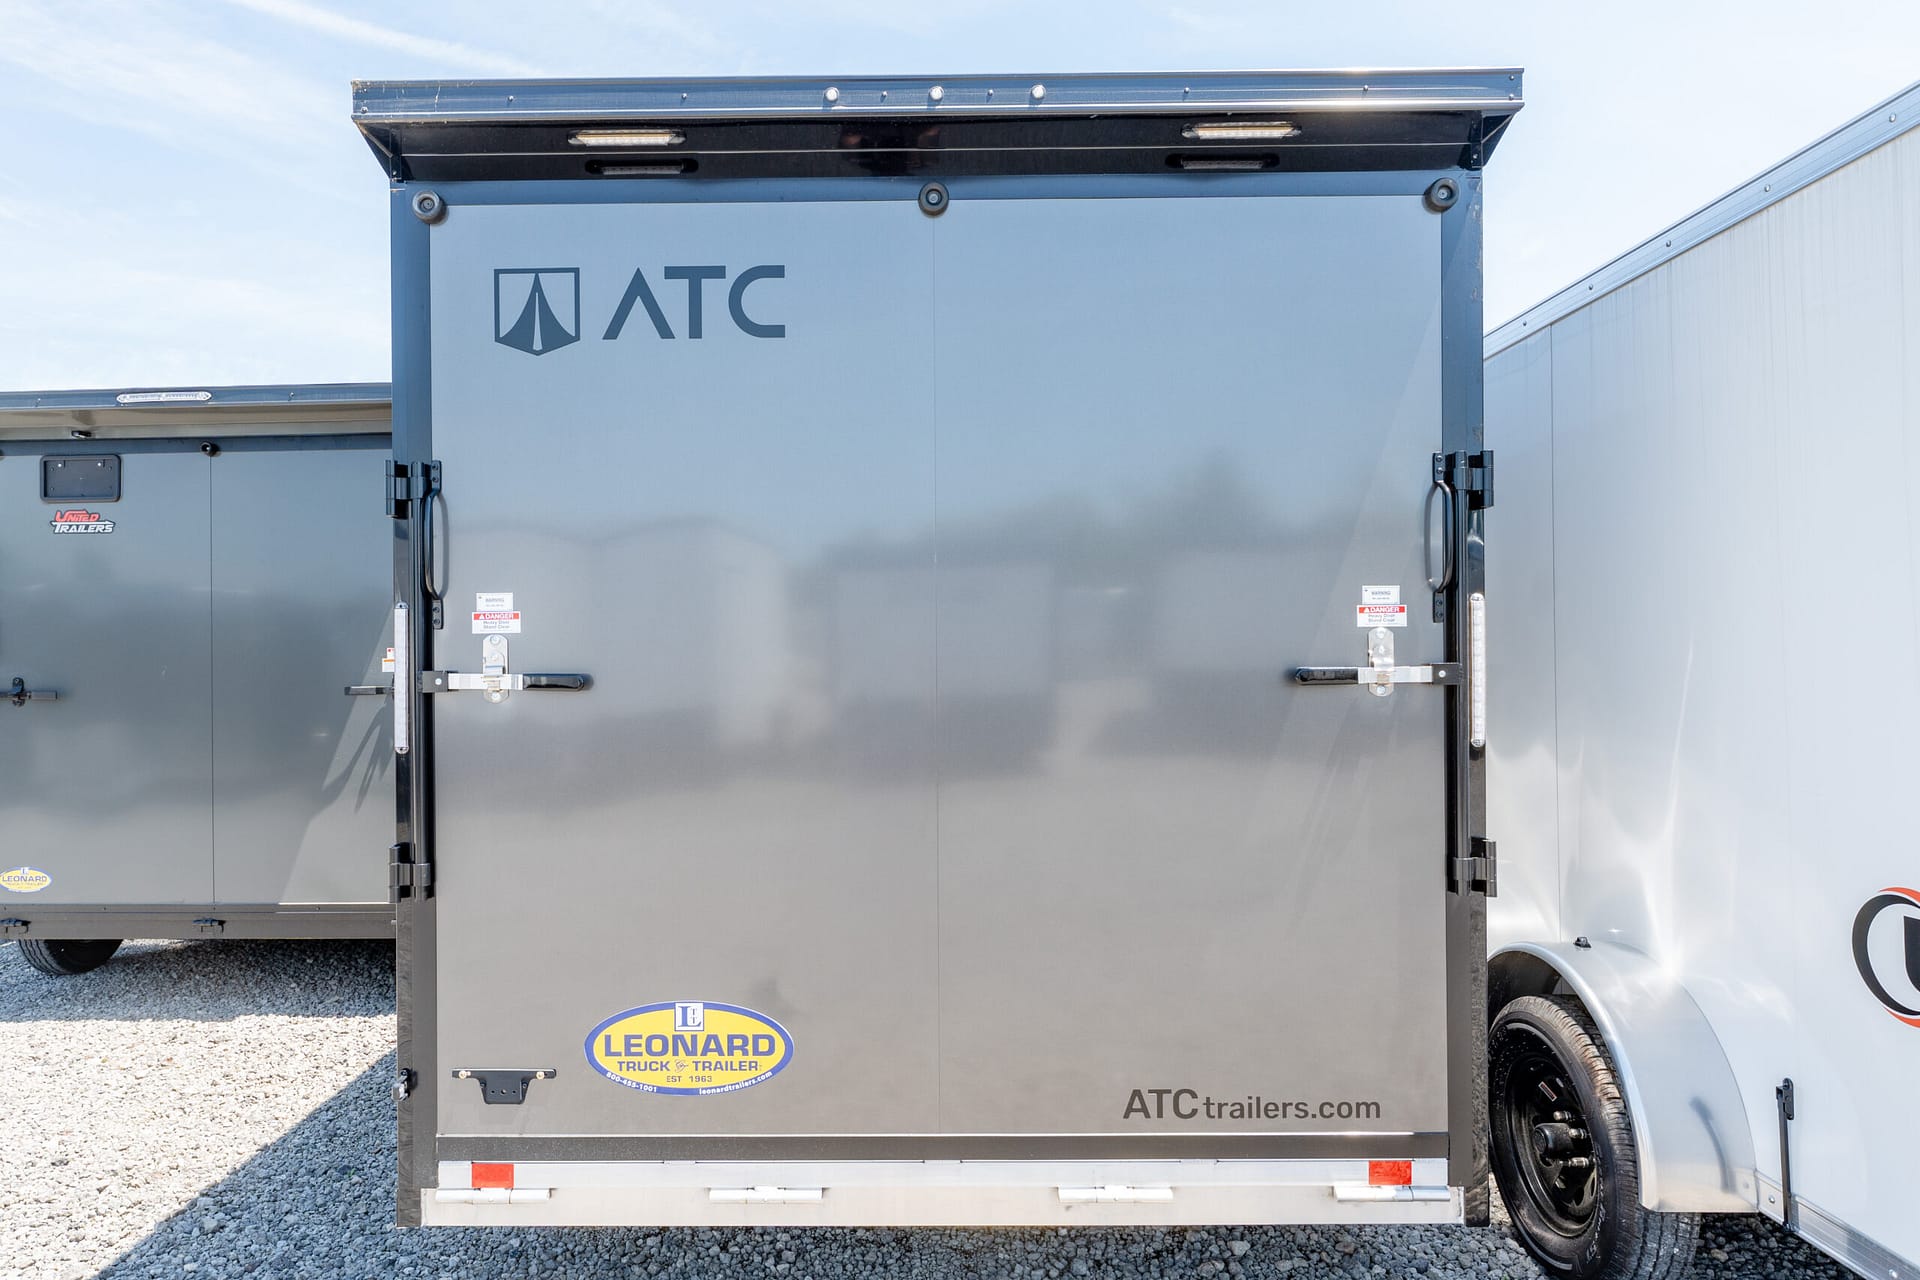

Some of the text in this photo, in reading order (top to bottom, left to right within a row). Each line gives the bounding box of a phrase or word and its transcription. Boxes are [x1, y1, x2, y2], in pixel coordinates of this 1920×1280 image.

[602, 265, 786, 340] ATC
[52, 521, 114, 533] TRAILERS
[604, 1034, 776, 1057] LEONARD
[617, 1060, 670, 1072] TRUCK
[692, 1060, 759, 1072] TRAILER
[606, 1071, 773, 1095] 800-455-1001 leonardtrailers.com
[666, 1075, 713, 1083] EST 1963
